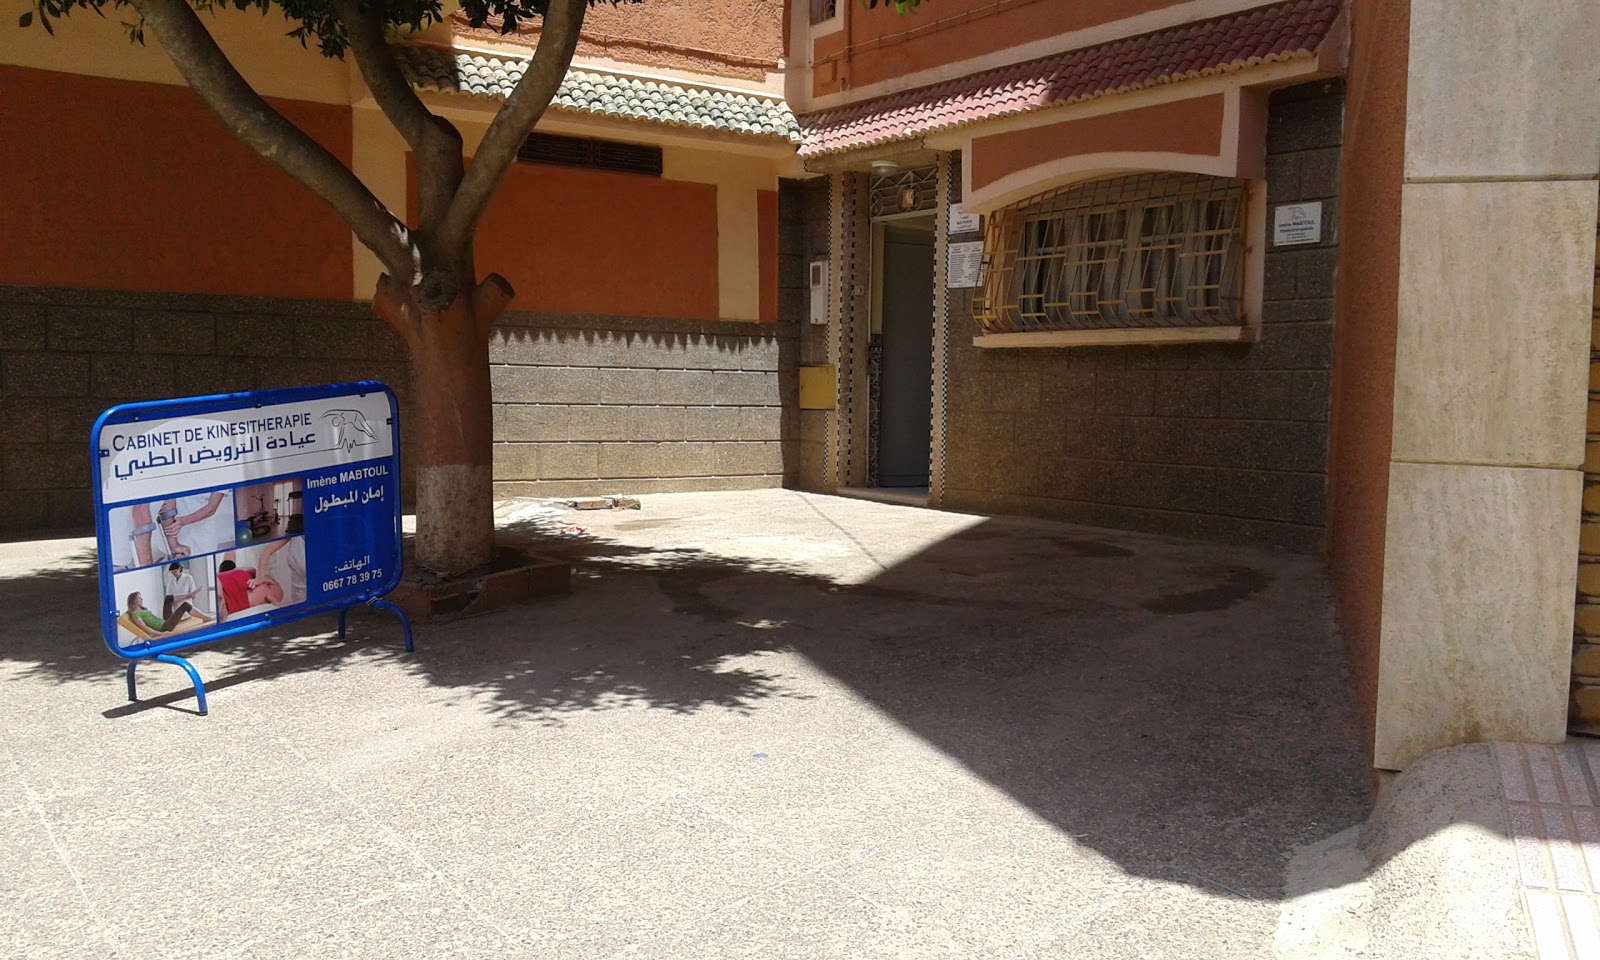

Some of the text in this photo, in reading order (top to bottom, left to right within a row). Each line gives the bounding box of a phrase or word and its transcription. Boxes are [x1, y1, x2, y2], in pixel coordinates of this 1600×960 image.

[113, 412, 312, 452] CABINET DE KINESITHERAPIE
[114, 431, 316, 480] عيادة الترويض الطبي
[307, 465, 388, 489] Imène MABTOUL
[314, 490, 358, 513] المبطول
[323, 568, 383, 591] 0667 78 39 75
